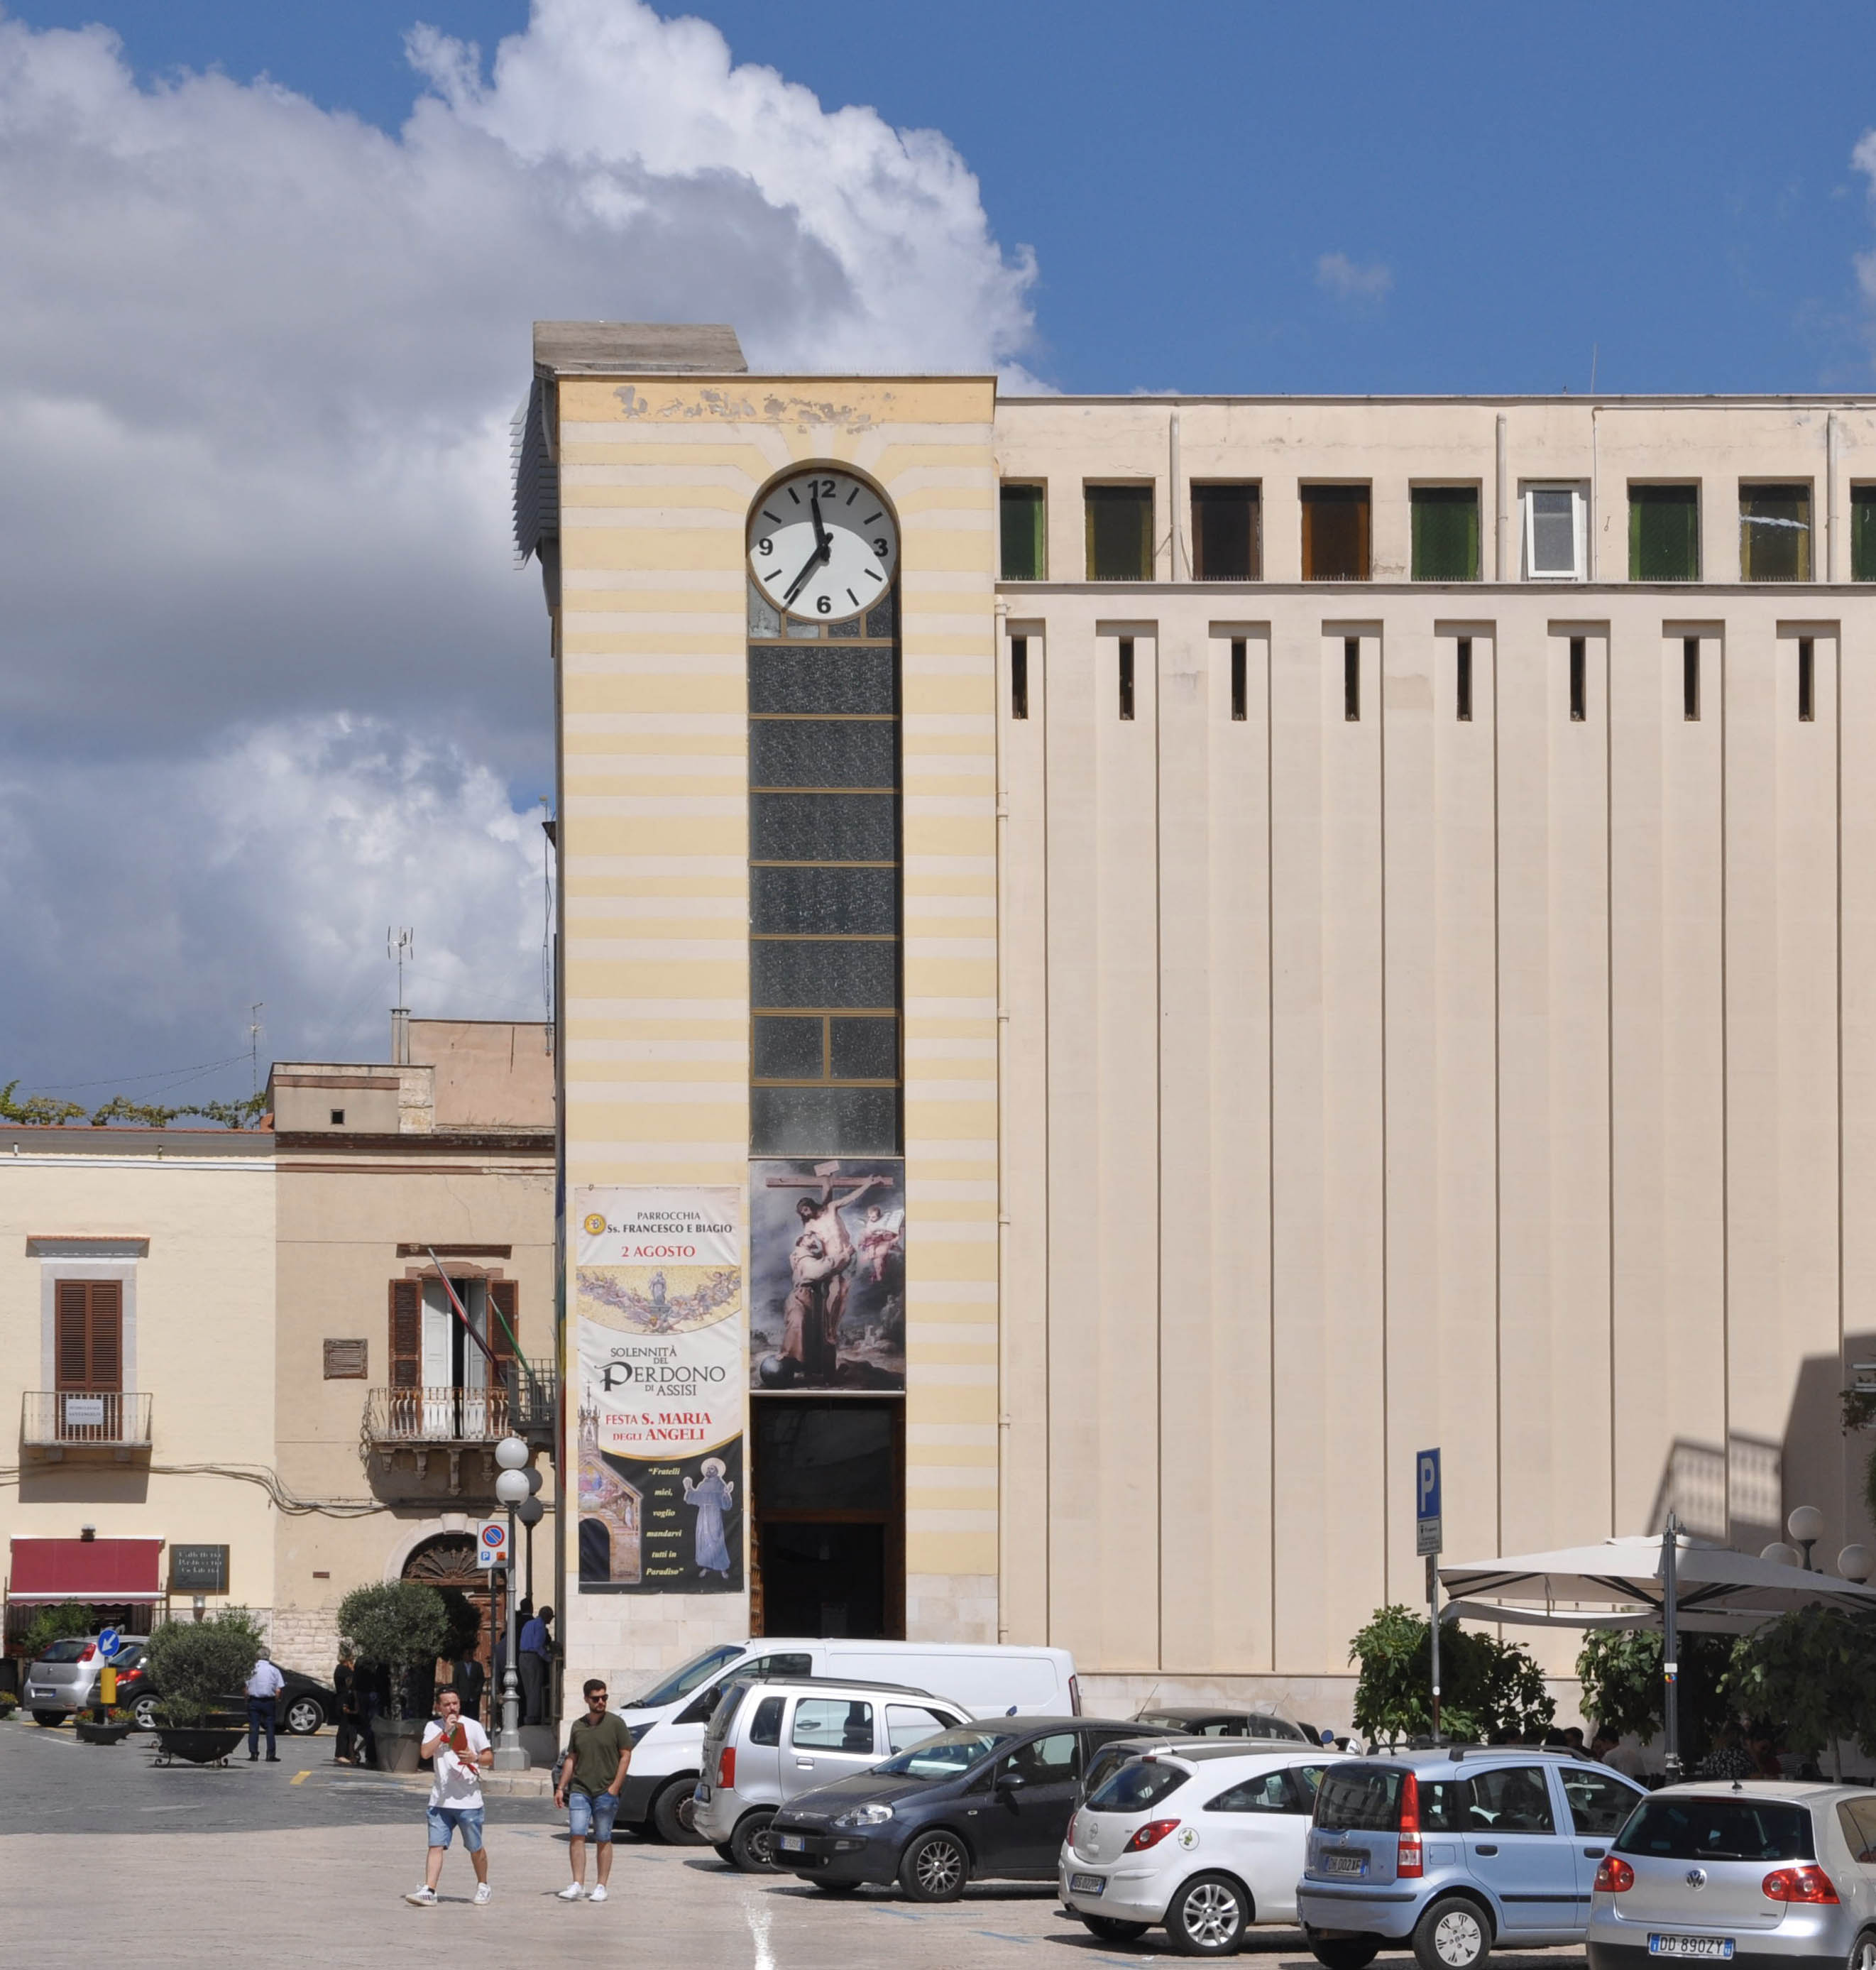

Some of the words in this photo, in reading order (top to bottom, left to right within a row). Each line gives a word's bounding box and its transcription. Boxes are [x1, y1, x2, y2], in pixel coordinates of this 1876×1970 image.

[807, 480, 836, 498] 12
[758, 537, 774, 556] 9
[873, 537, 889, 557] 3
[816, 595, 832, 614] 6
[637, 1211, 701, 1220] PARROCCHIA
[607, 1224, 620, 1233] Ss.
[622, 1224, 684, 1233] FRANCESCO
[687, 1224, 693, 1233] E
[696, 1224, 733, 1233] BIAGIO
[621, 1246, 629, 1257] 2
[633, 1246, 696, 1257] AGOSTO
[610, 1345, 677, 1357] SOLENNITÀ
[594, 1361, 725, 1392] PERDONO
[656, 1384, 697, 1396] ASSISI
[605, 1414, 637, 1425] FESTA
[641, 1413, 654, 1425] S.
[658, 1413, 712, 1425] MARIA
[613, 1433, 642, 1441] DEGLI
[645, 1428, 705, 1440] ANGELI
[1420, 1457, 1435, 1512] P
[646, 1529, 683, 1538] mandarvi
[1660, 1937, 1676, 1951] DD
[1681, 1938, 1723, 1954] 890ZY
